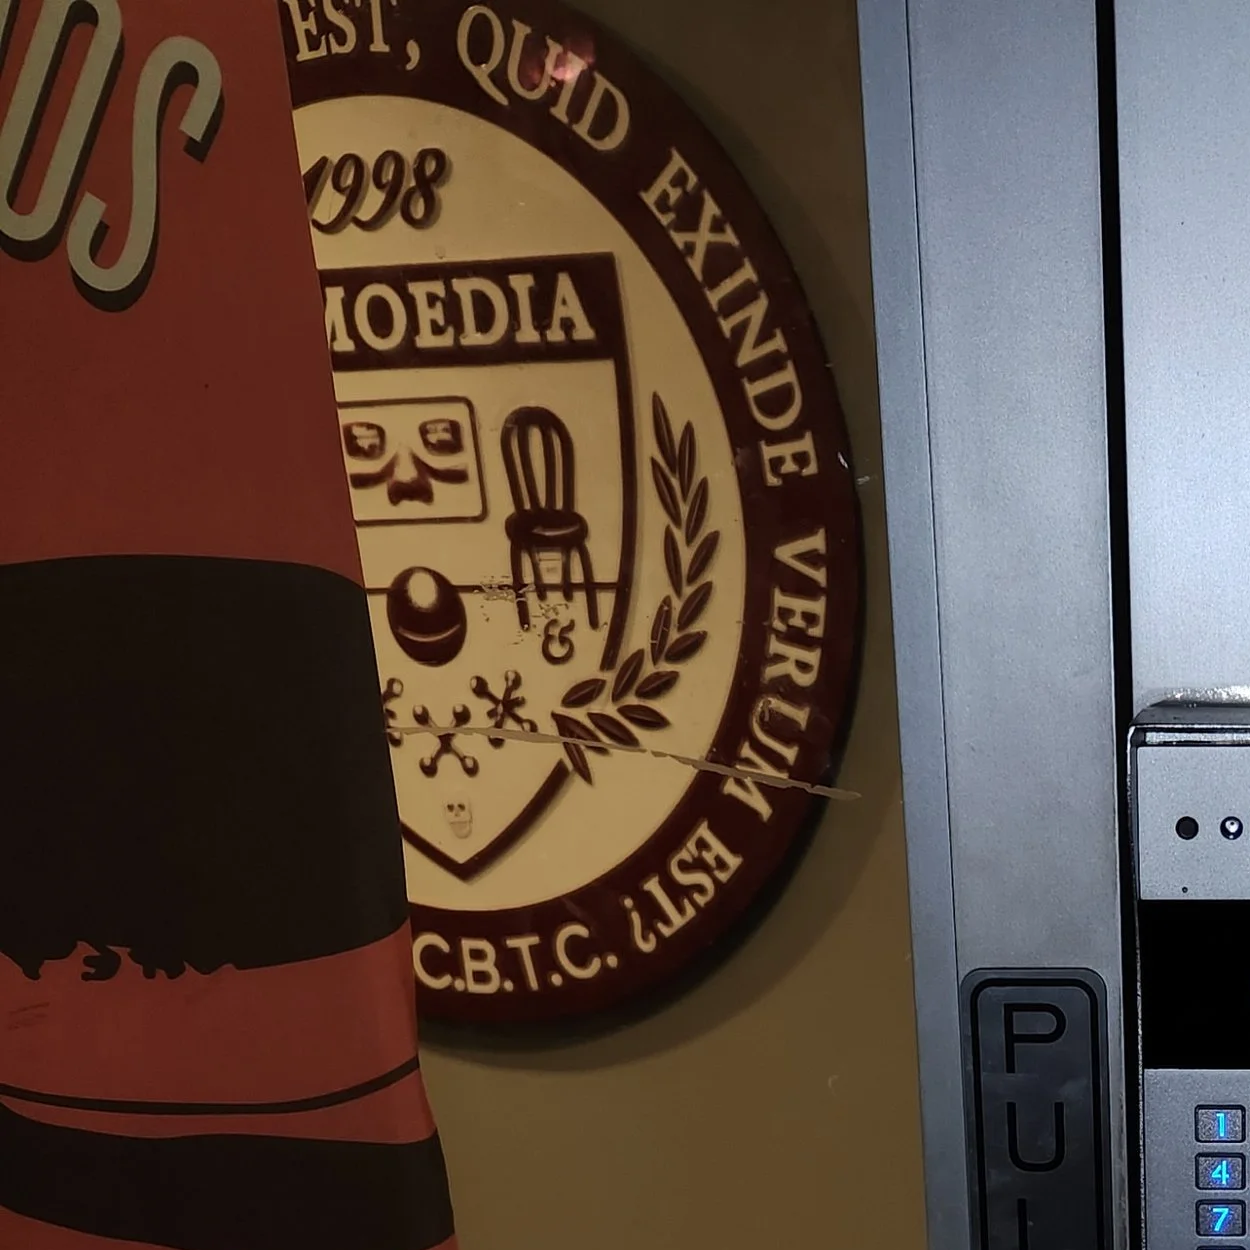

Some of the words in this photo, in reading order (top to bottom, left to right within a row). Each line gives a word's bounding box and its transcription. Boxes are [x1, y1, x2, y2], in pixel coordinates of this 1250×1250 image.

[456, 5, 631, 151] QUID
[0, 0, 223, 302] OS
[302, 147, 450, 234] 1998
[639, 147, 819, 487] EXINDE
[722, 527, 828, 822] VERUM
[411, 922, 618, 995] C.B.T.C.
[1215, 1112, 1226, 1138] 1
[1210, 1159, 1230, 1185] 4
[1211, 1207, 1230, 1232] 7
